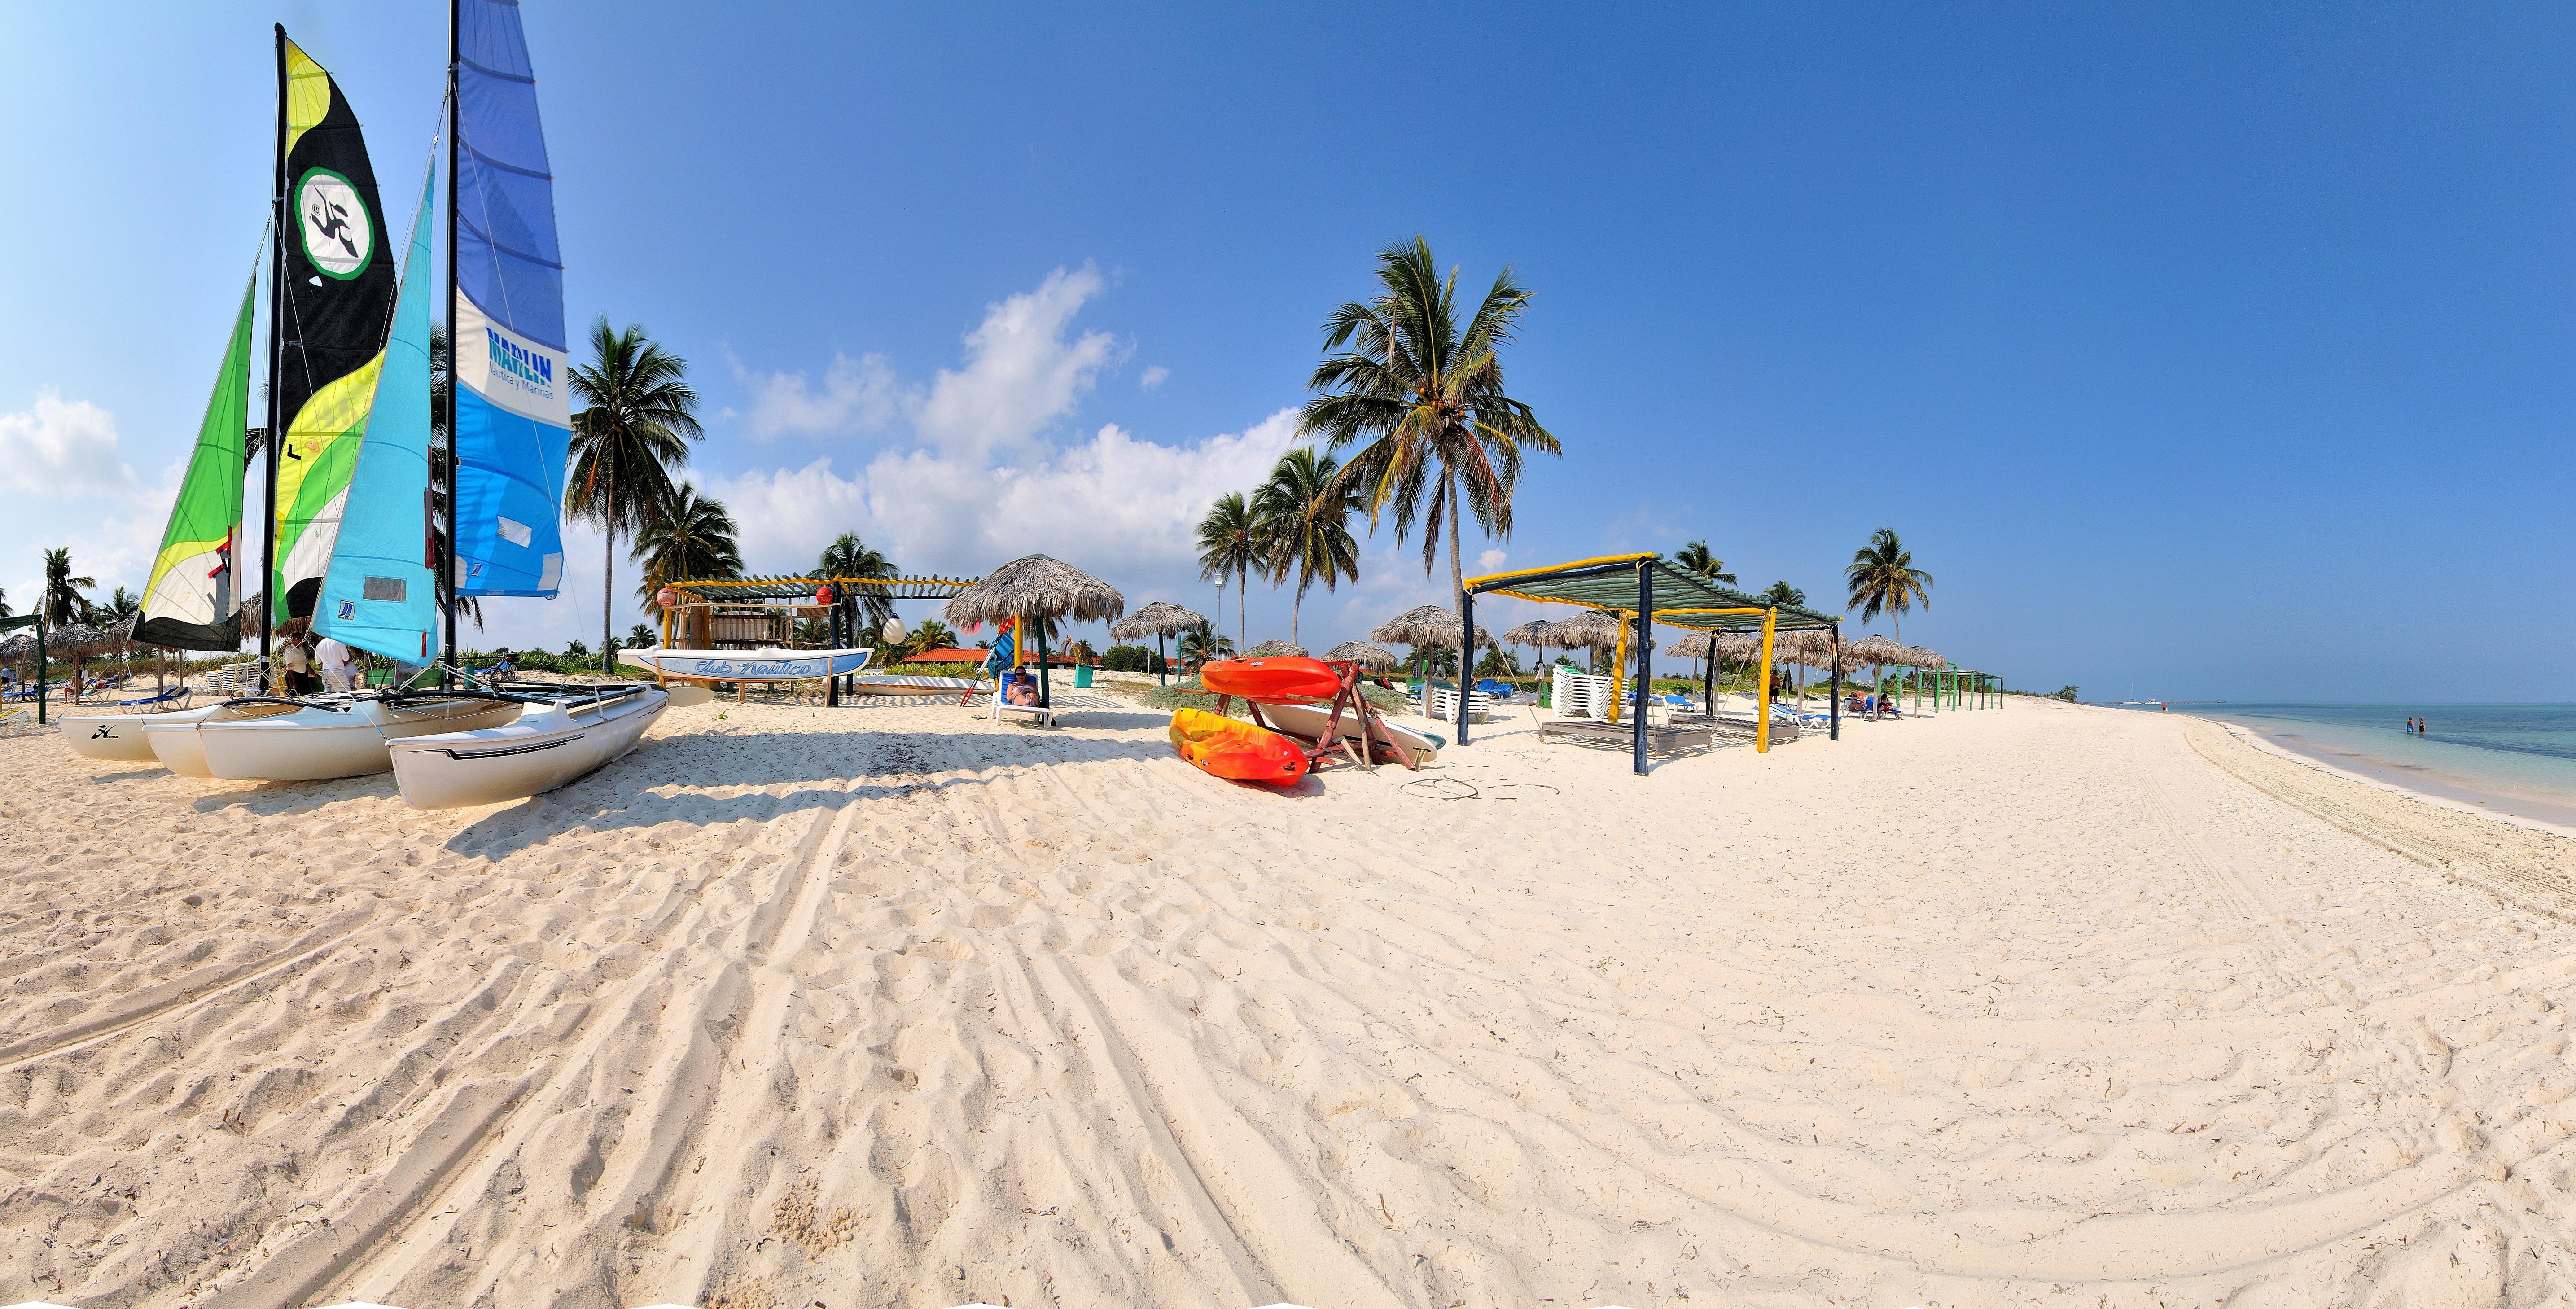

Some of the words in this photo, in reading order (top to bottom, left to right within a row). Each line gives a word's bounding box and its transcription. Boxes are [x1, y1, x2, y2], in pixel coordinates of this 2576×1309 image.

[314, 206, 319, 214] 15
[486, 327, 552, 388] MARLIN
[489, 361, 513, 385] Náutica
[516, 380, 520, 390] y
[522, 380, 554, 399] Marinas
[695, 660, 732, 674] Club
